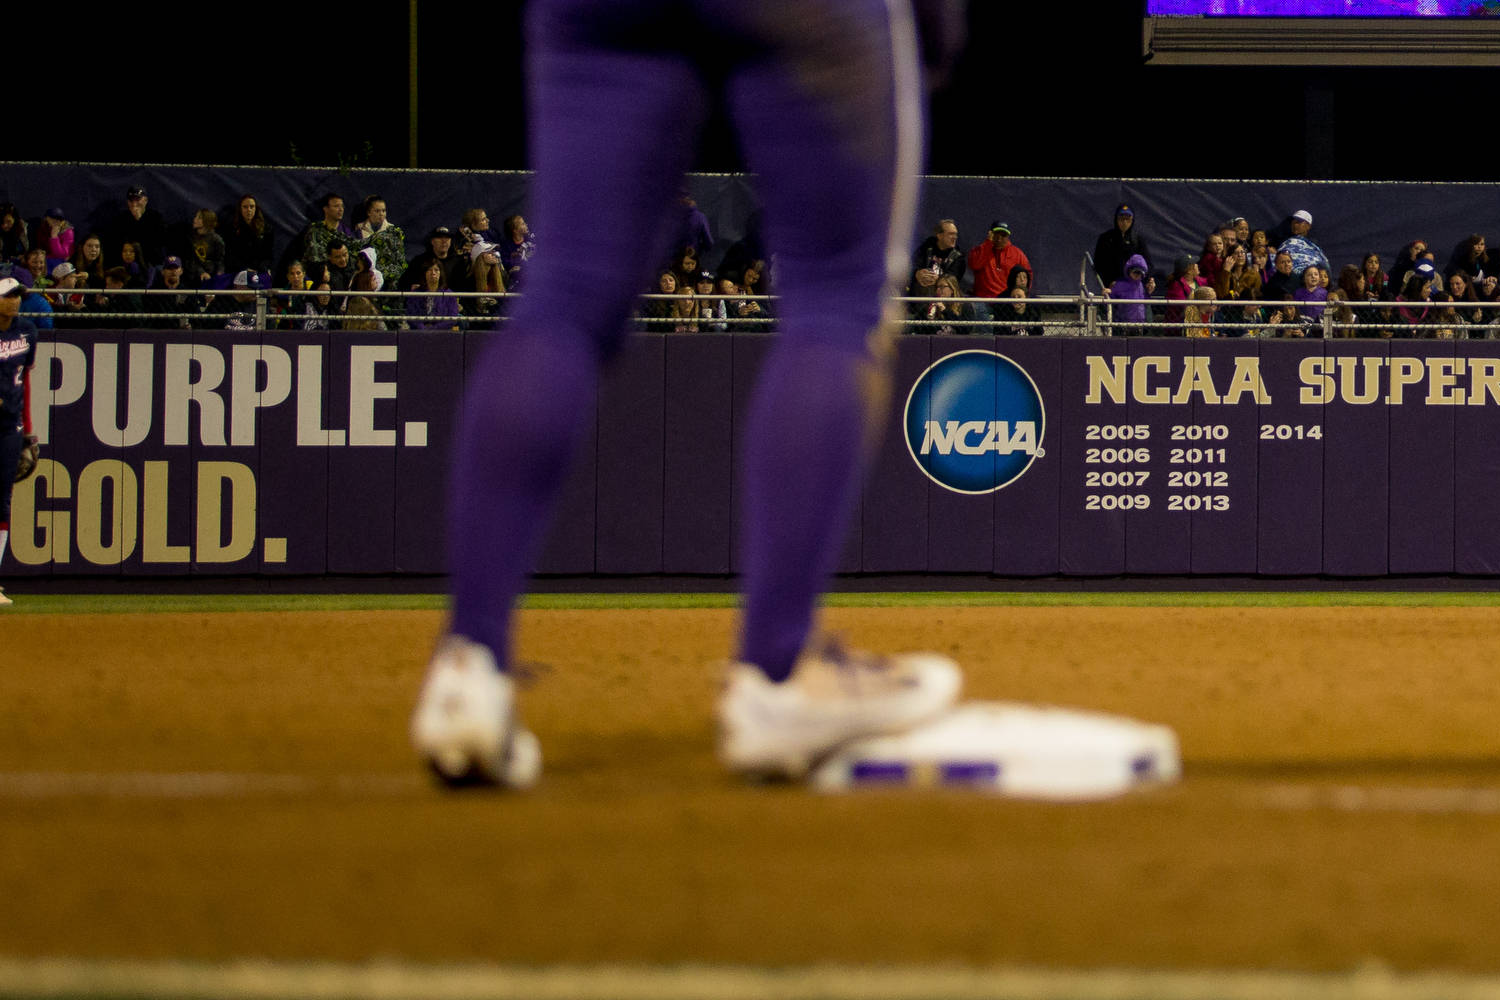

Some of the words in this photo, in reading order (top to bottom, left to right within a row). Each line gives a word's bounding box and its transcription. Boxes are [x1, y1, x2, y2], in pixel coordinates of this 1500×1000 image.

[1085, 356, 1272, 404] NCAA
[29, 342, 428, 447] PURPLE.
[920, 420, 1037, 456] NCAA
[1085, 425, 1150, 440] 2005
[1171, 425, 1229, 440] 2010
[1260, 425, 1322, 440] 2014
[1085, 448, 1150, 463] 2006
[1170, 448, 1227, 463] 2011
[1085, 471, 1150, 487] 2007
[1168, 471, 1229, 487] 2012
[9, 458, 288, 565] GOLD.
[1085, 495, 1150, 510] 2009
[1168, 495, 1230, 511] 2013
